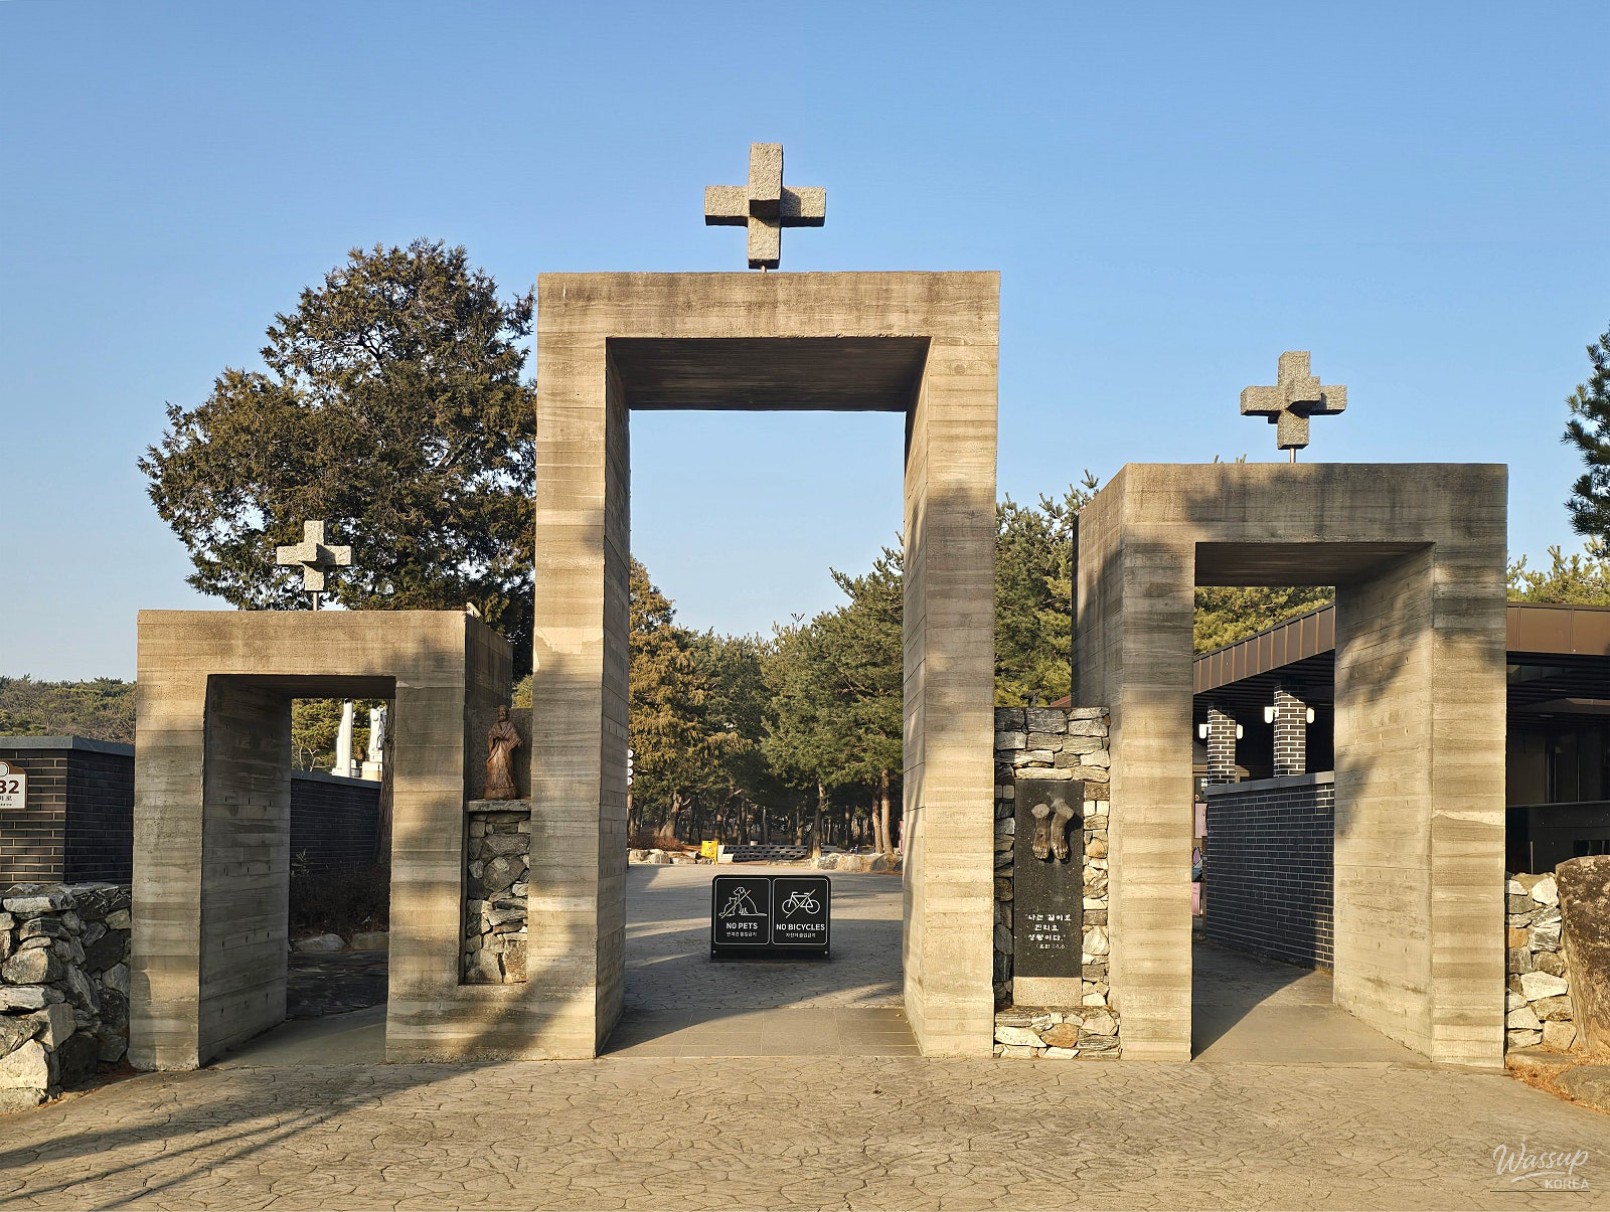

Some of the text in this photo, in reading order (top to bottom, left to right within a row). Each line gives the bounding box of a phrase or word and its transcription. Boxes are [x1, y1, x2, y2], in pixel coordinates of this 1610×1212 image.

[726, 922, 758, 930] NO PETS
[776, 923, 826, 931] NO BICYCLES
